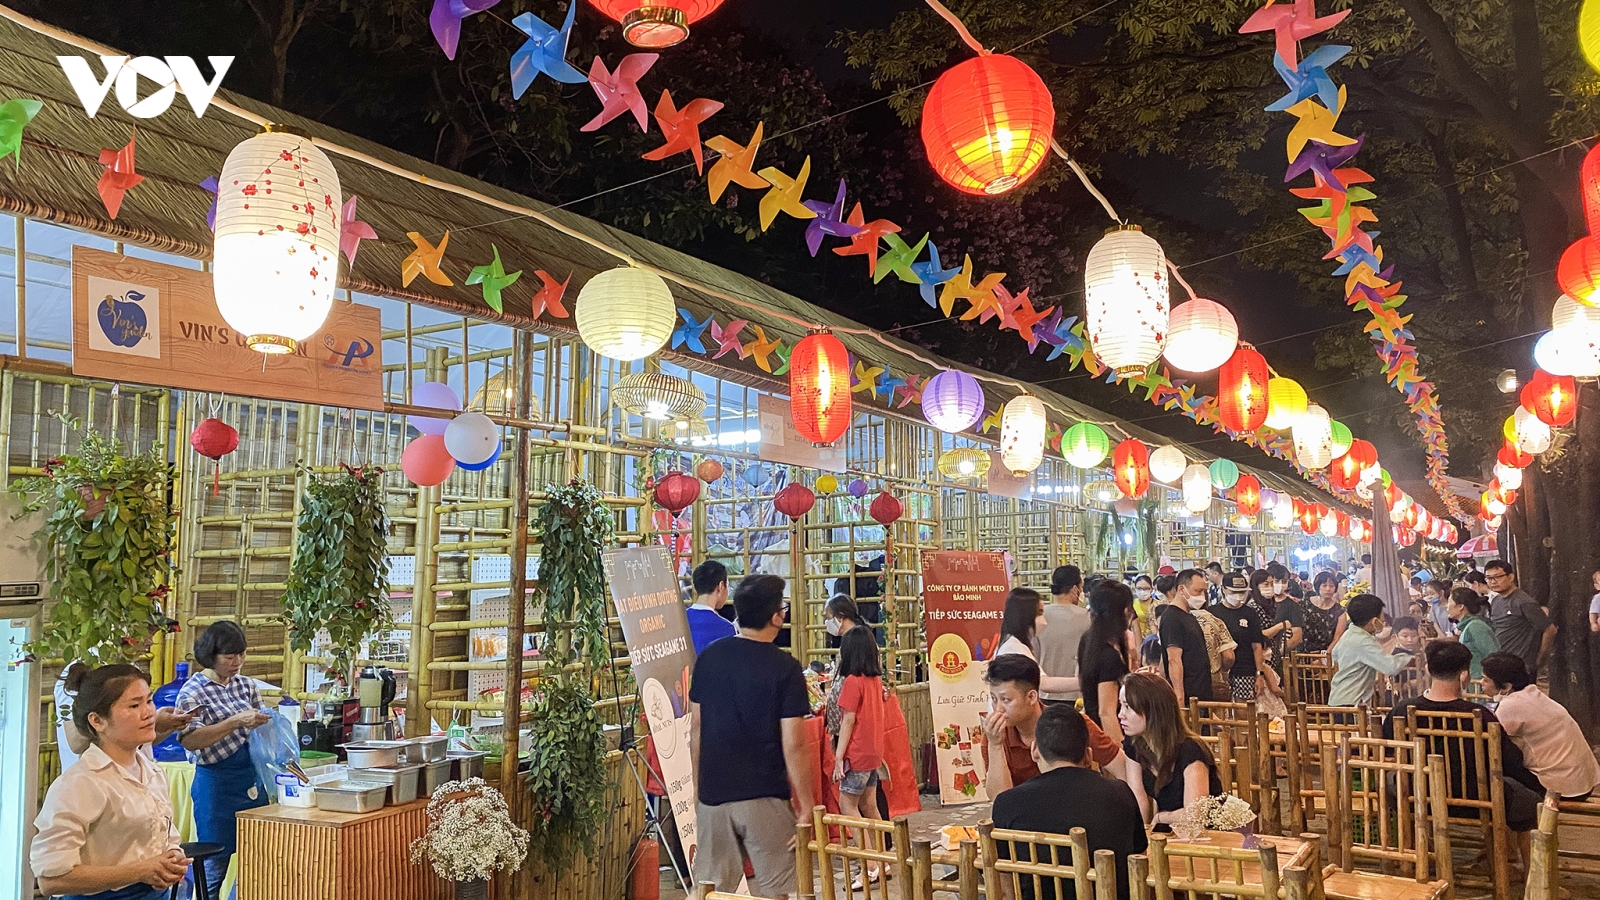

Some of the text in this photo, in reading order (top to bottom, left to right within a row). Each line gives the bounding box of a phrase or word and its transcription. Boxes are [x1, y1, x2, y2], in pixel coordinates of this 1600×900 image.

[179, 321, 229, 345] VIN'S
[926, 584, 945, 592] CÔNG
[962, 584, 979, 592] BÁNH
[992, 585, 1005, 593] KẸO
[952, 593, 965, 601] BẢO
[928, 607, 945, 620] TIẾP
[946, 609, 962, 620] SỨC
[963, 610, 998, 620] SEAGAME
[638, 613, 666, 634] ORGANIC
[641, 643, 655, 664] SỨC
[654, 637, 681, 659] SEAGAME
[680, 635, 688, 651] 31
[676, 800, 689, 816] 120g
